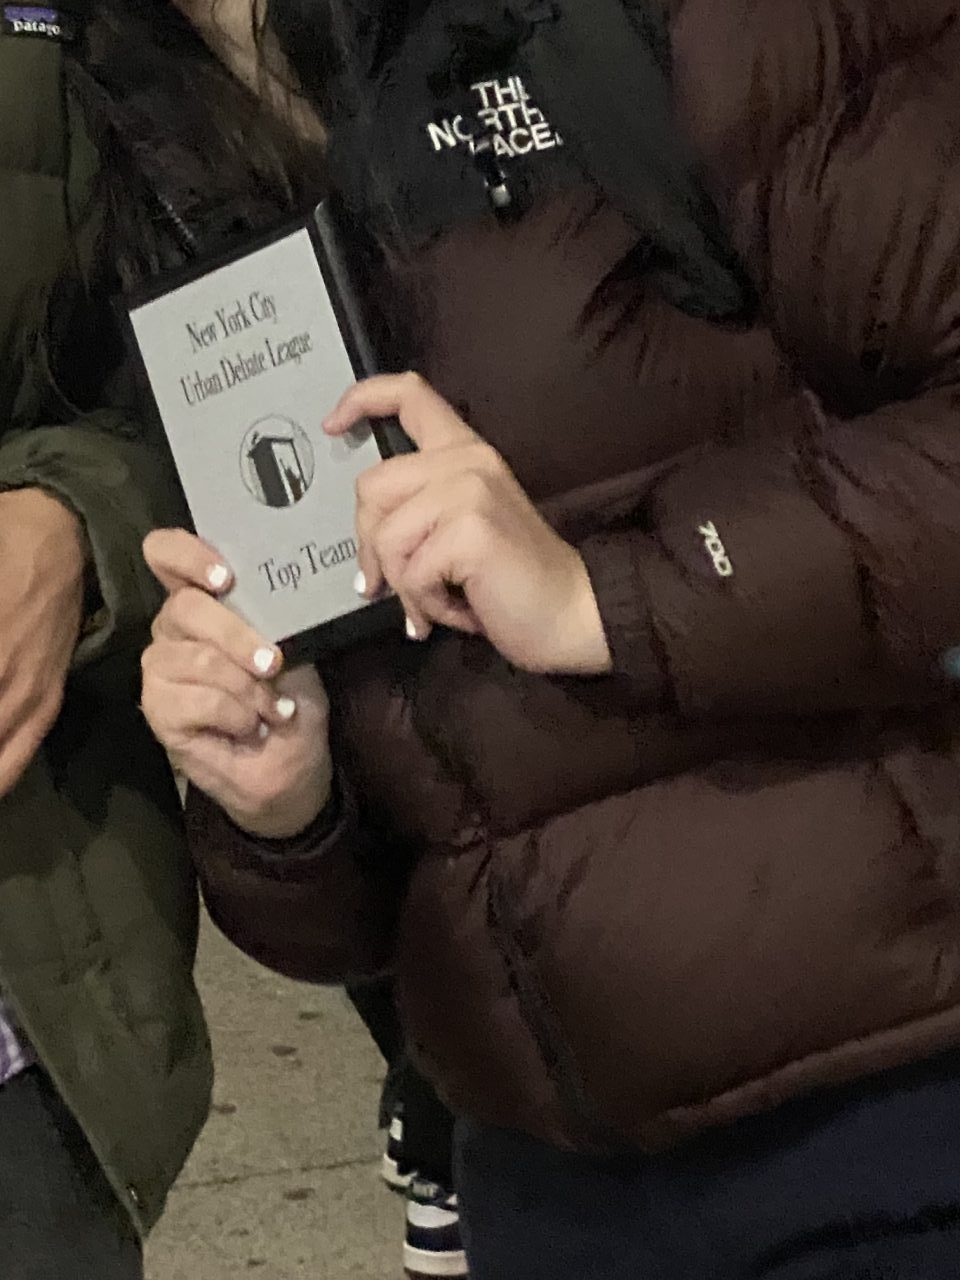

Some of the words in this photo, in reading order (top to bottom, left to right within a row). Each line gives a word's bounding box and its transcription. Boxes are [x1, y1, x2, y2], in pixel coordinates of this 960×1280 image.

[186, 321, 218, 353] New
[215, 299, 252, 338] York
[249, 291, 278, 325] City
[180, 370, 223, 406] Urban
[220, 354, 267, 389] Debate
[265, 332, 312, 367] League
[258, 558, 301, 592] Top
[300, 537, 357, 575] Team
